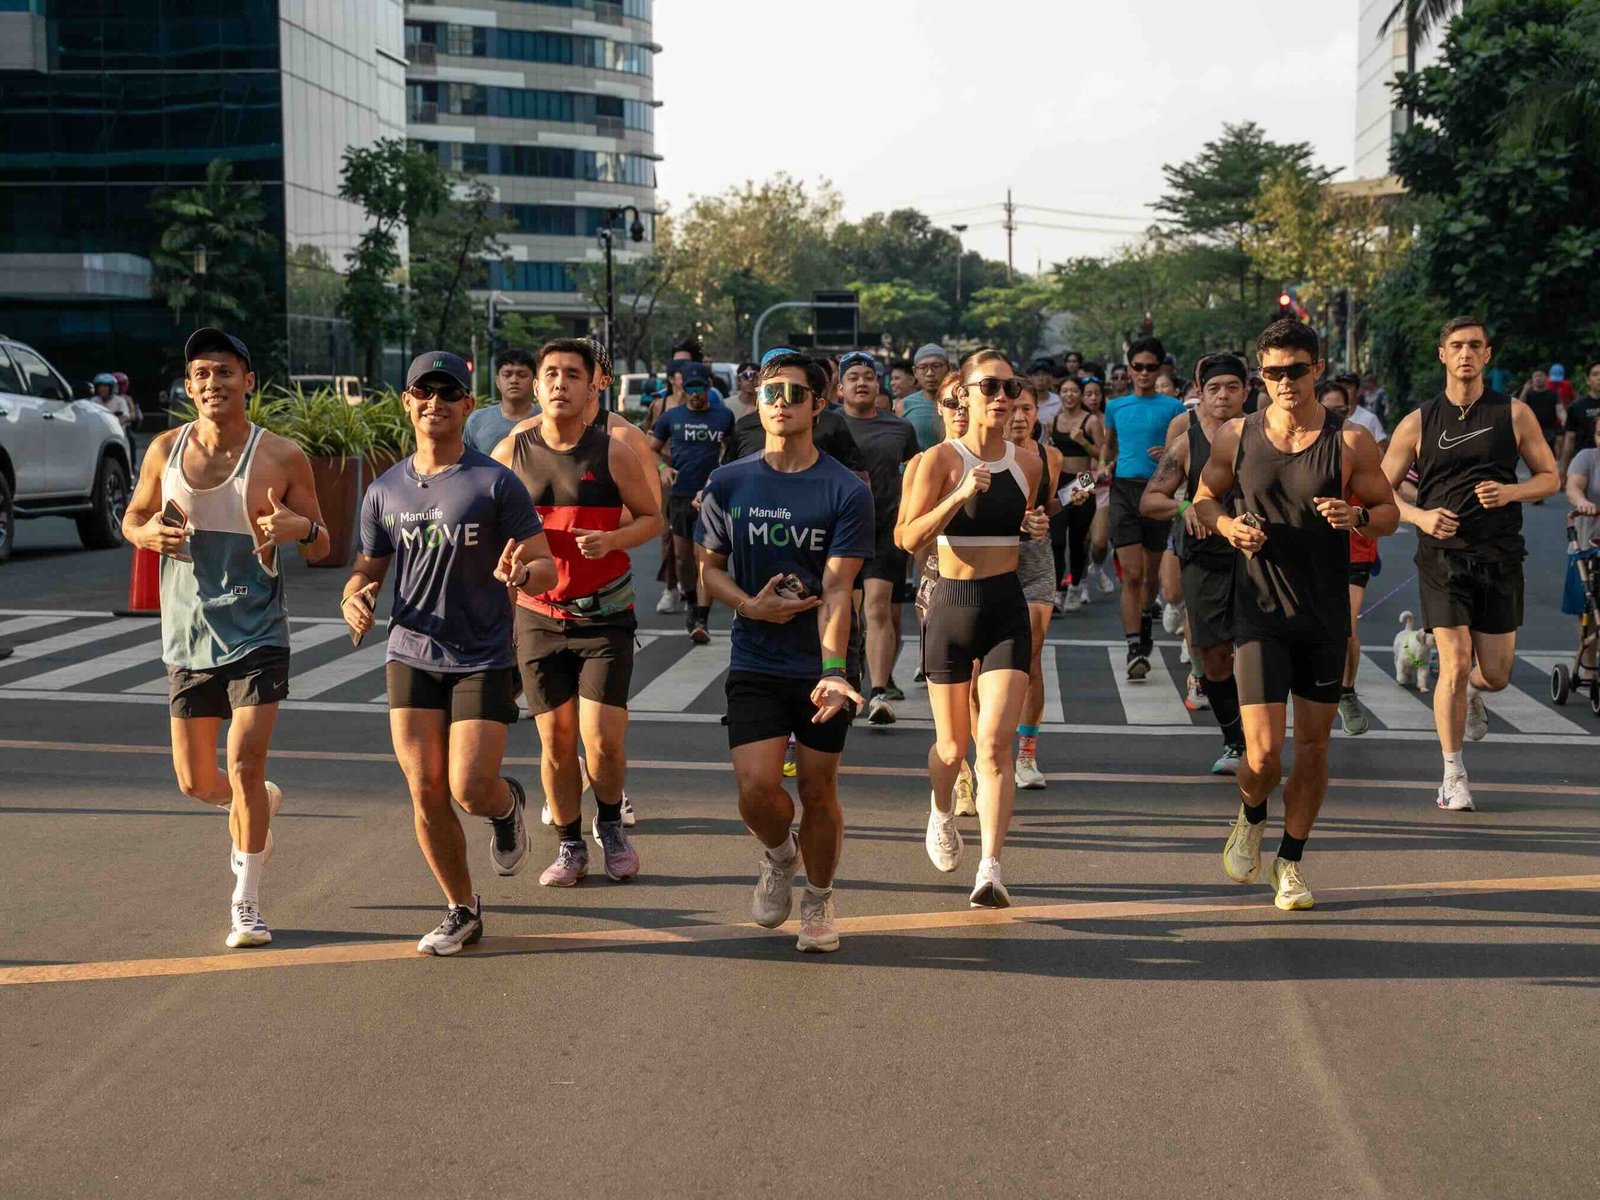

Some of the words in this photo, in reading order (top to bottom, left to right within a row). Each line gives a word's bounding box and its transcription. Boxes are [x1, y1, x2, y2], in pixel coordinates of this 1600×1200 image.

[684, 430, 724, 442] MOVE
[400, 507, 443, 522] Manulife
[748, 506, 792, 520] Manulife
[401, 523, 480, 549] MOVE
[748, 522, 827, 551] MOVE
